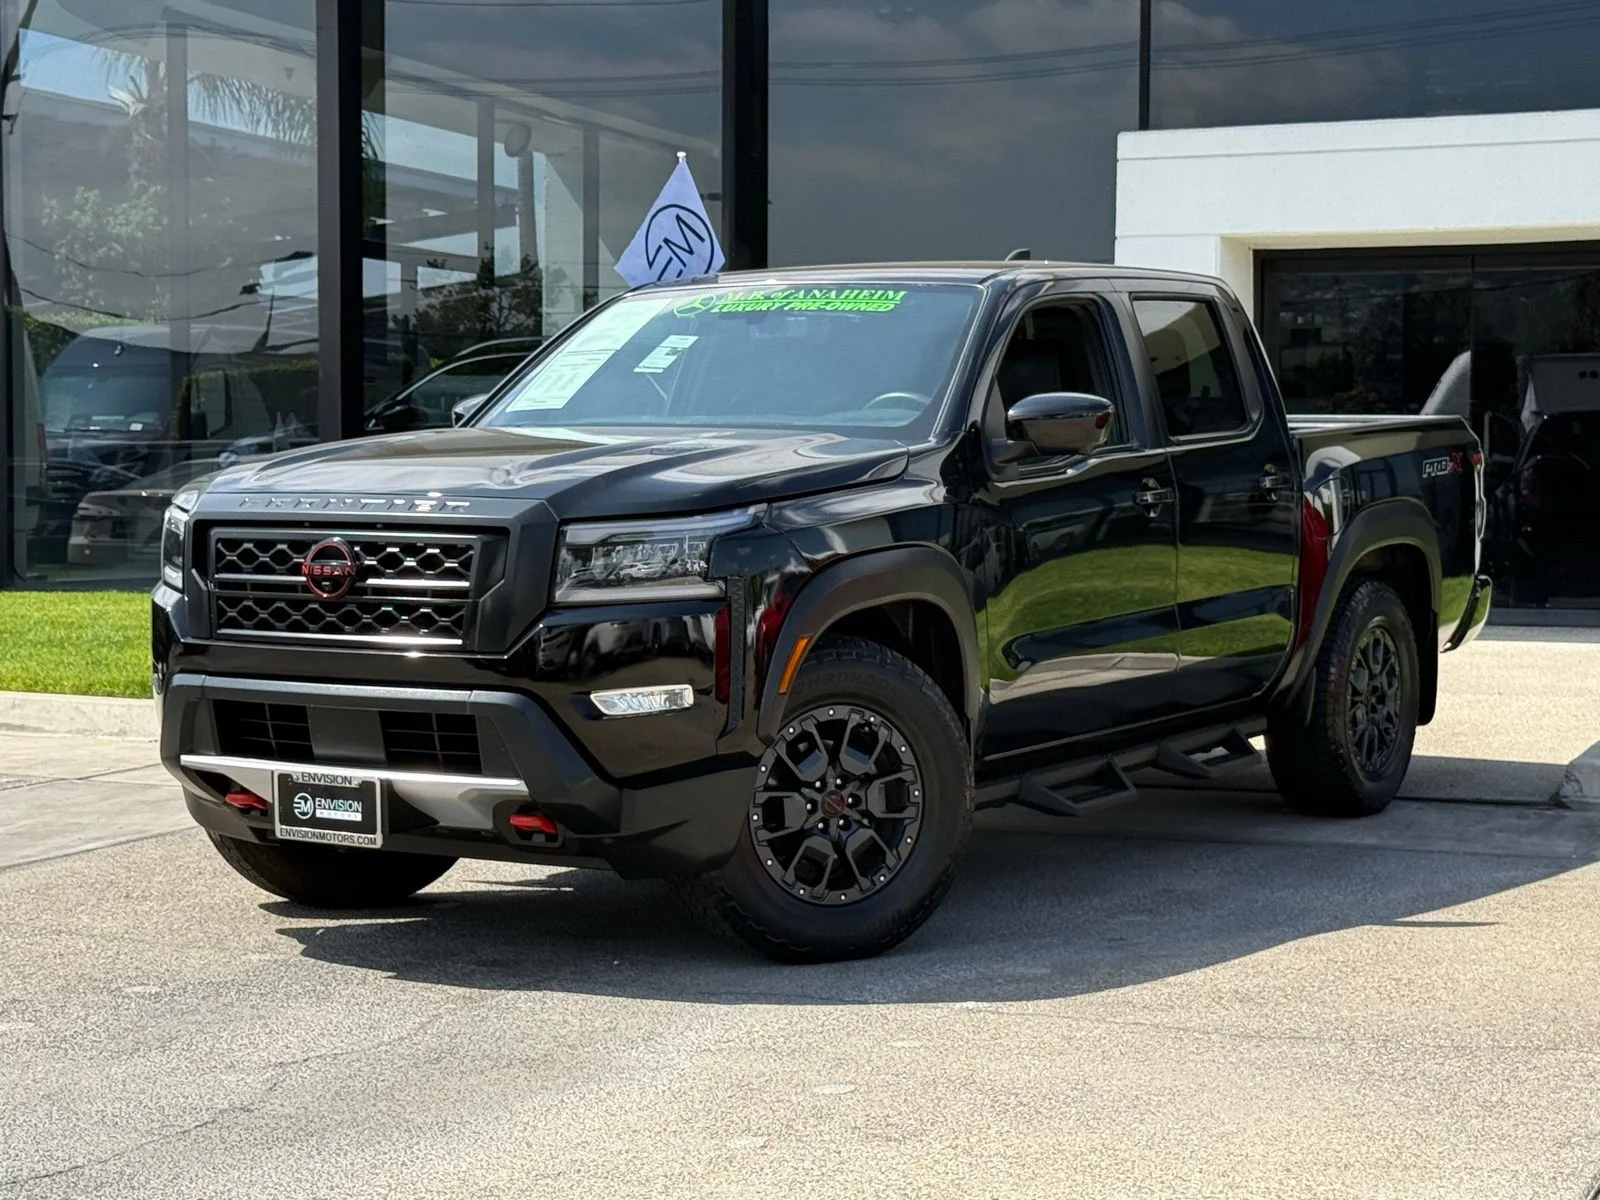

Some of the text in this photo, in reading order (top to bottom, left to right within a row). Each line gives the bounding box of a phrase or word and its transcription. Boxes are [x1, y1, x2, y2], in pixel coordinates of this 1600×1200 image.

[770, 290, 789, 299] of
[791, 289, 907, 301] ANAHEIM
[710, 302, 896, 313] LUXURY PRE-OWNED
[238, 497, 471, 512] FRONTIER
[302, 564, 356, 575] NISSAN
[301, 772, 353, 785] ENVISION
[315, 798, 362, 812] ENVISION
[280, 828, 377, 846] ENVISIONMOTORS.COM
